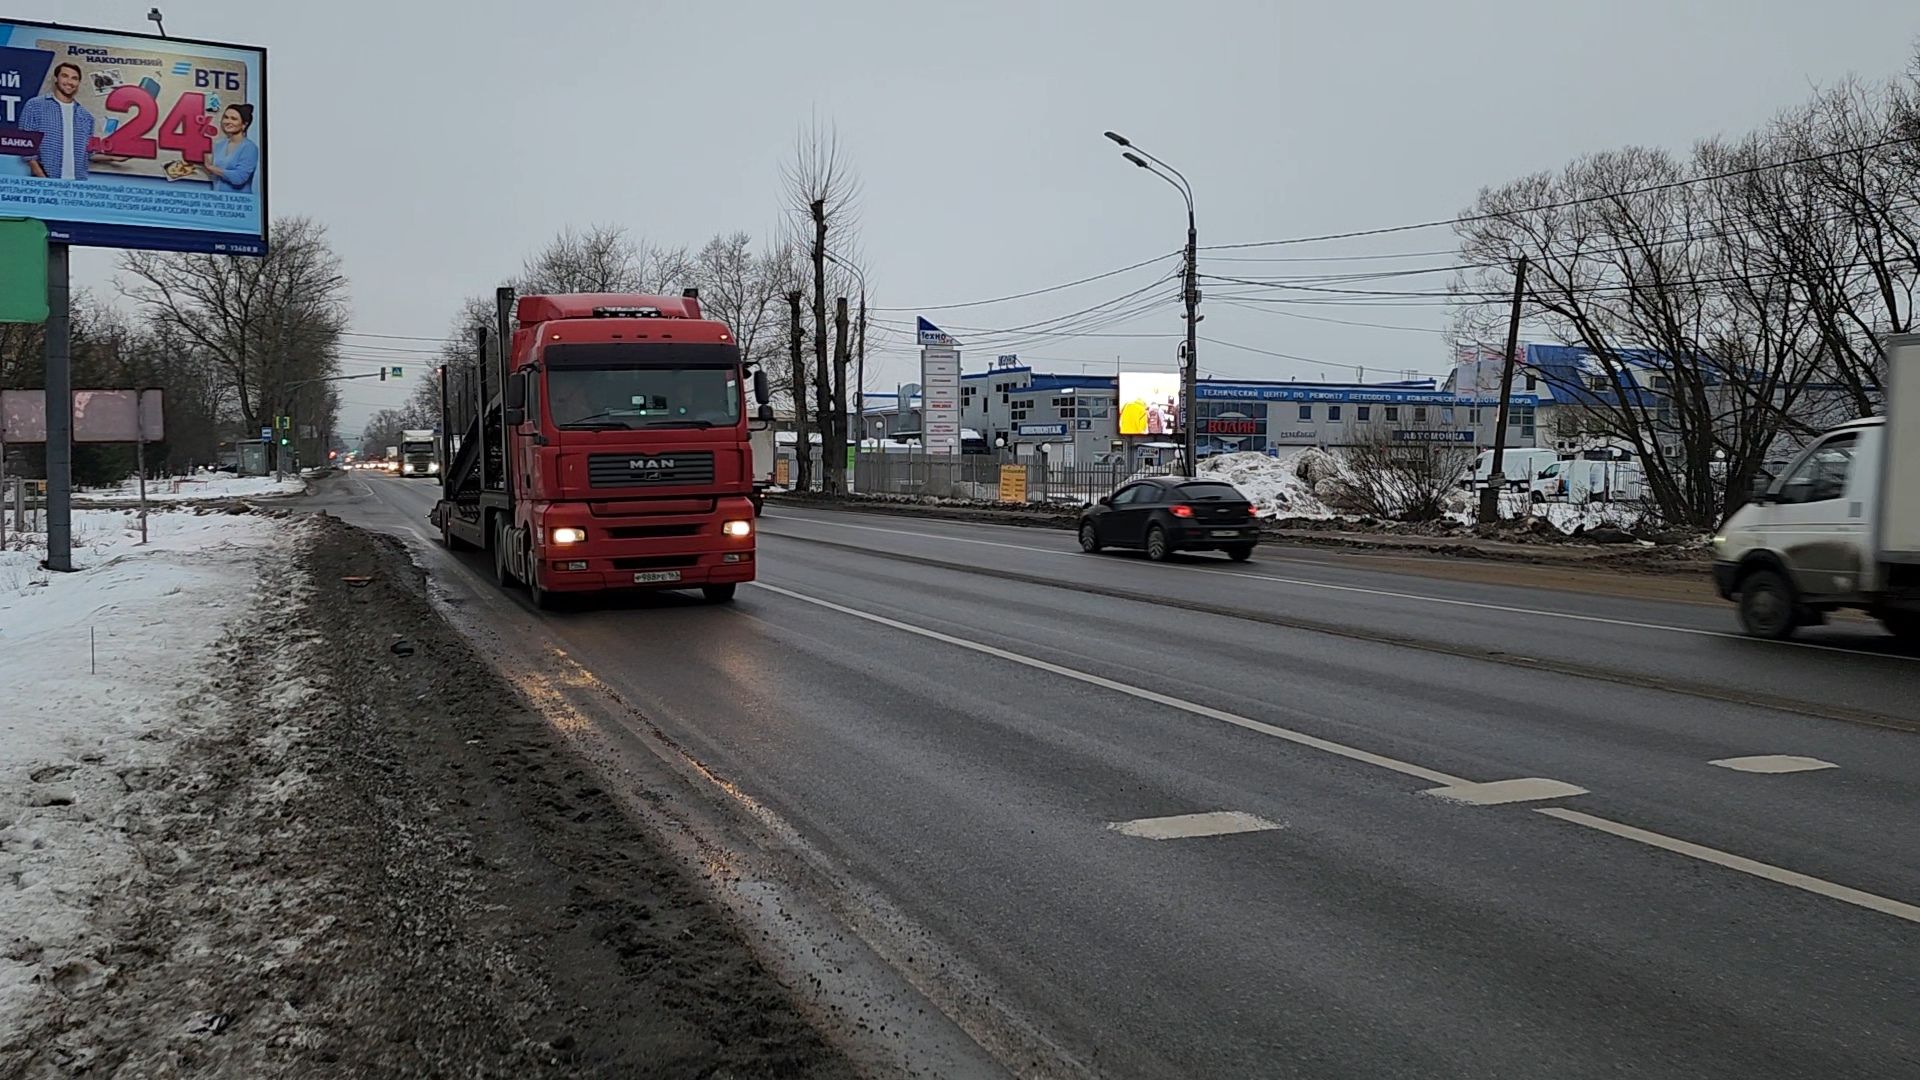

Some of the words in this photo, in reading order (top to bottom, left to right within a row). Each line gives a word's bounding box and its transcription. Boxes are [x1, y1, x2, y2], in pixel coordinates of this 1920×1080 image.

[67, 45, 108, 56] Доска
[194, 68, 240, 91] ВТБ
[0, 136, 35, 148] БАНКА
[1203, 388, 1259, 398] ТЕХНИЧЕСКИЙ
[1263, 390, 1289, 399] ЦЕНТР
[1309, 392, 1343, 400] РЕМОНТУ
[1348, 393, 1391, 401] ЛЕГКОВОГО
[1403, 431, 1466, 441] АВТОМОЙКА
[630, 459, 675, 469] MAN
